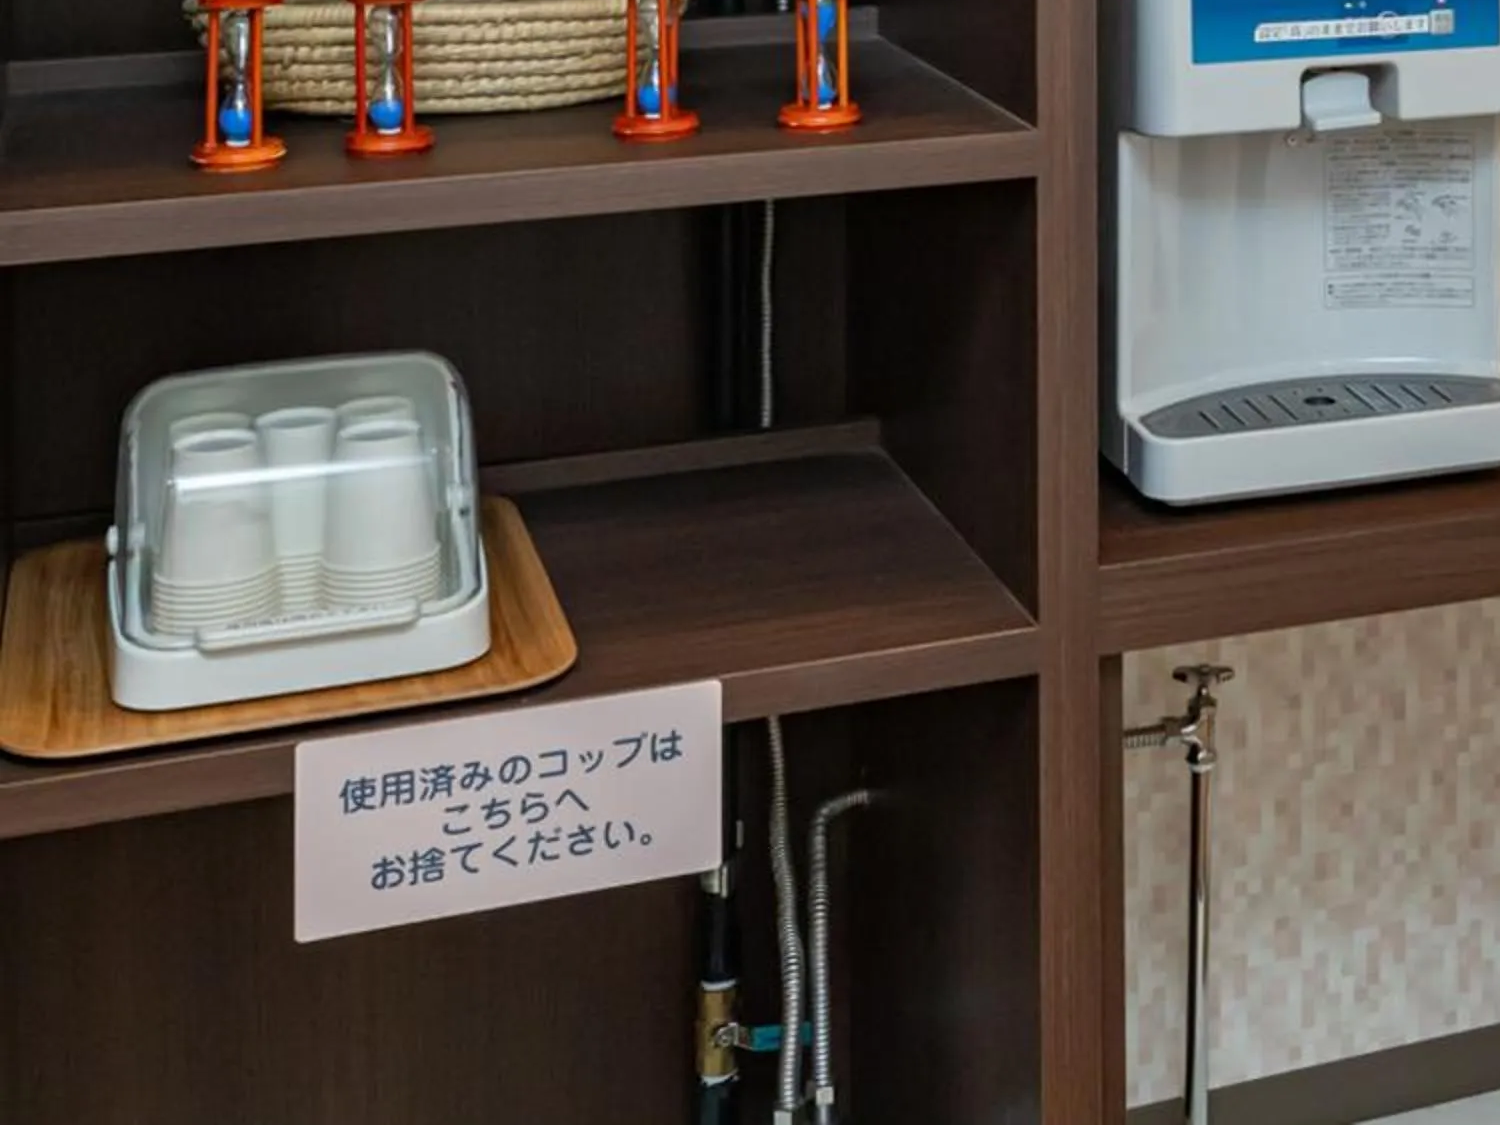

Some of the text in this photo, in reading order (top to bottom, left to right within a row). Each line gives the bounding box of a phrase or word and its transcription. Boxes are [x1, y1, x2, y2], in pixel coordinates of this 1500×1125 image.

[338, 729, 684, 814] 使用済みのコップは
[442, 788, 590, 837] こちらへ
[370, 820, 655, 891] お捨てください。
